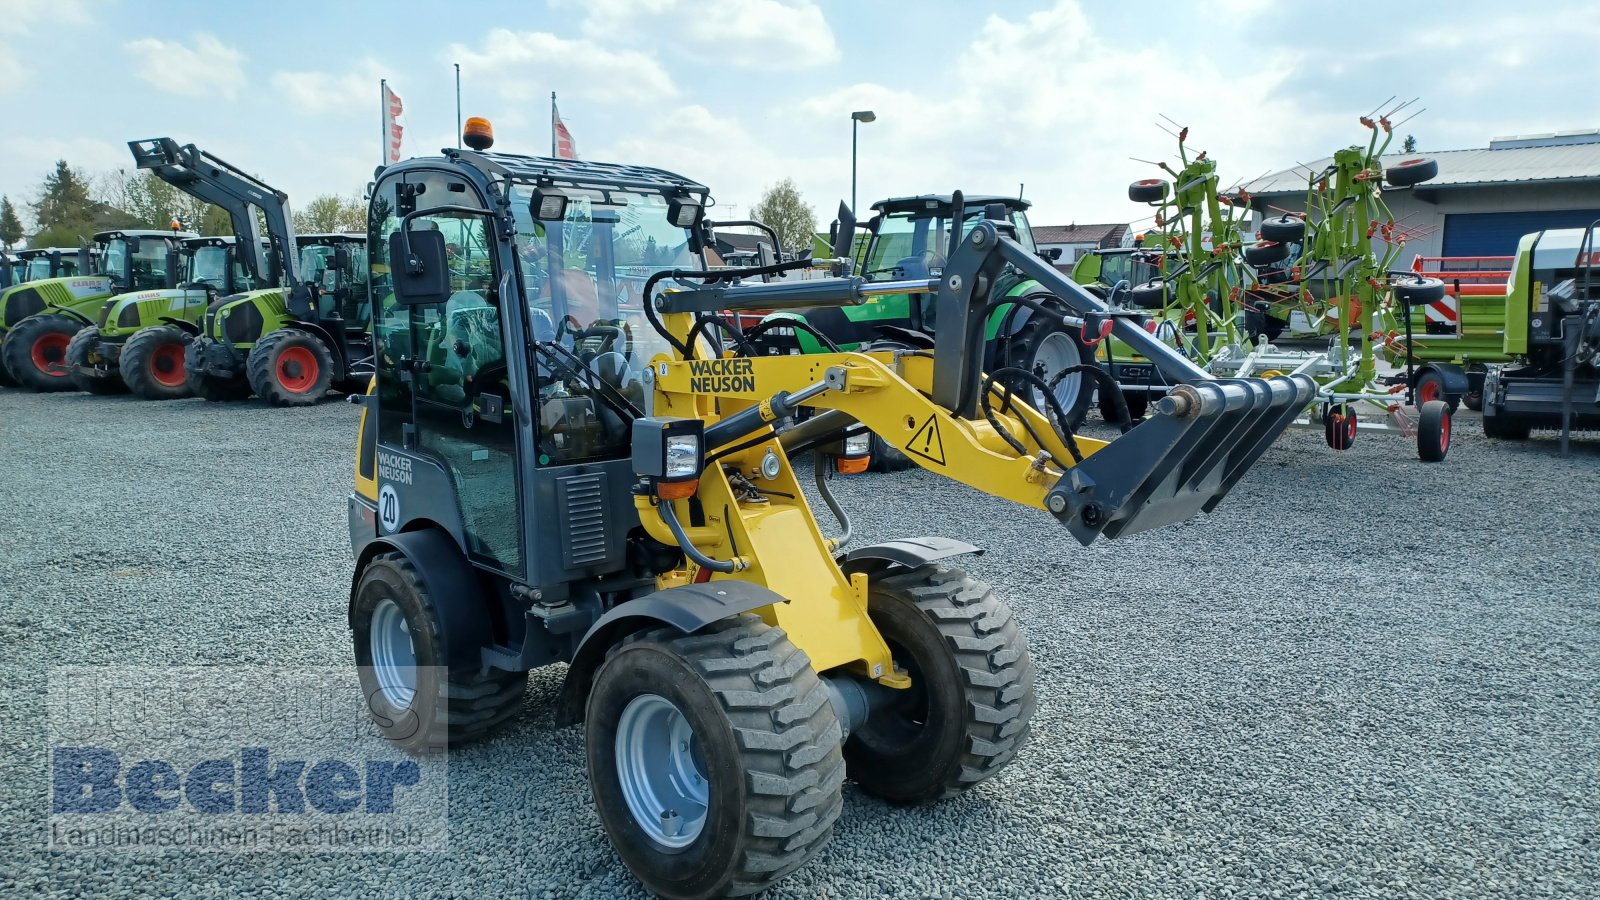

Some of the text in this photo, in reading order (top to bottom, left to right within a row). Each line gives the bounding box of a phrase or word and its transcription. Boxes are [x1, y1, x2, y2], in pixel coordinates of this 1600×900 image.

[72, 280, 102, 288] CLAAS
[137, 292, 161, 300] CLAAS
[689, 359, 754, 376] WACKER
[691, 376, 755, 392] NEUSON
[378, 452, 412, 471] WACKER
[379, 465, 412, 485] NEUSON
[383, 492, 395, 524] 20
